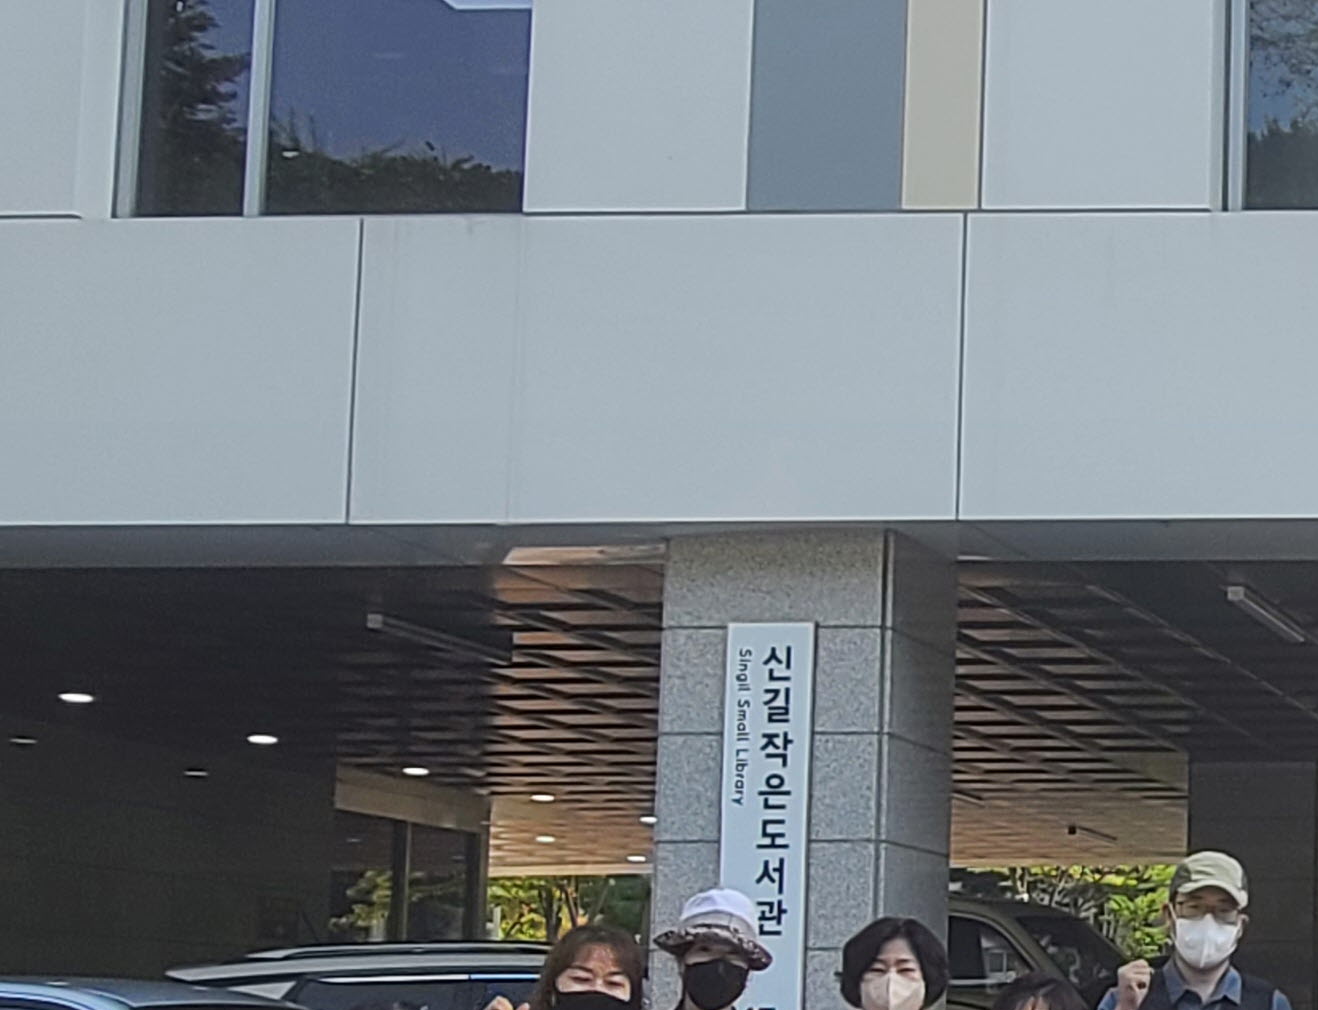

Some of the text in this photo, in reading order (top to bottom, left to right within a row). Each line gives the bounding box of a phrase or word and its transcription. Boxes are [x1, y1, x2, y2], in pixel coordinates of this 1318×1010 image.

[731, 648, 752, 806] Singil Small Library
[755, 645, 794, 937] 신길작은도서관
